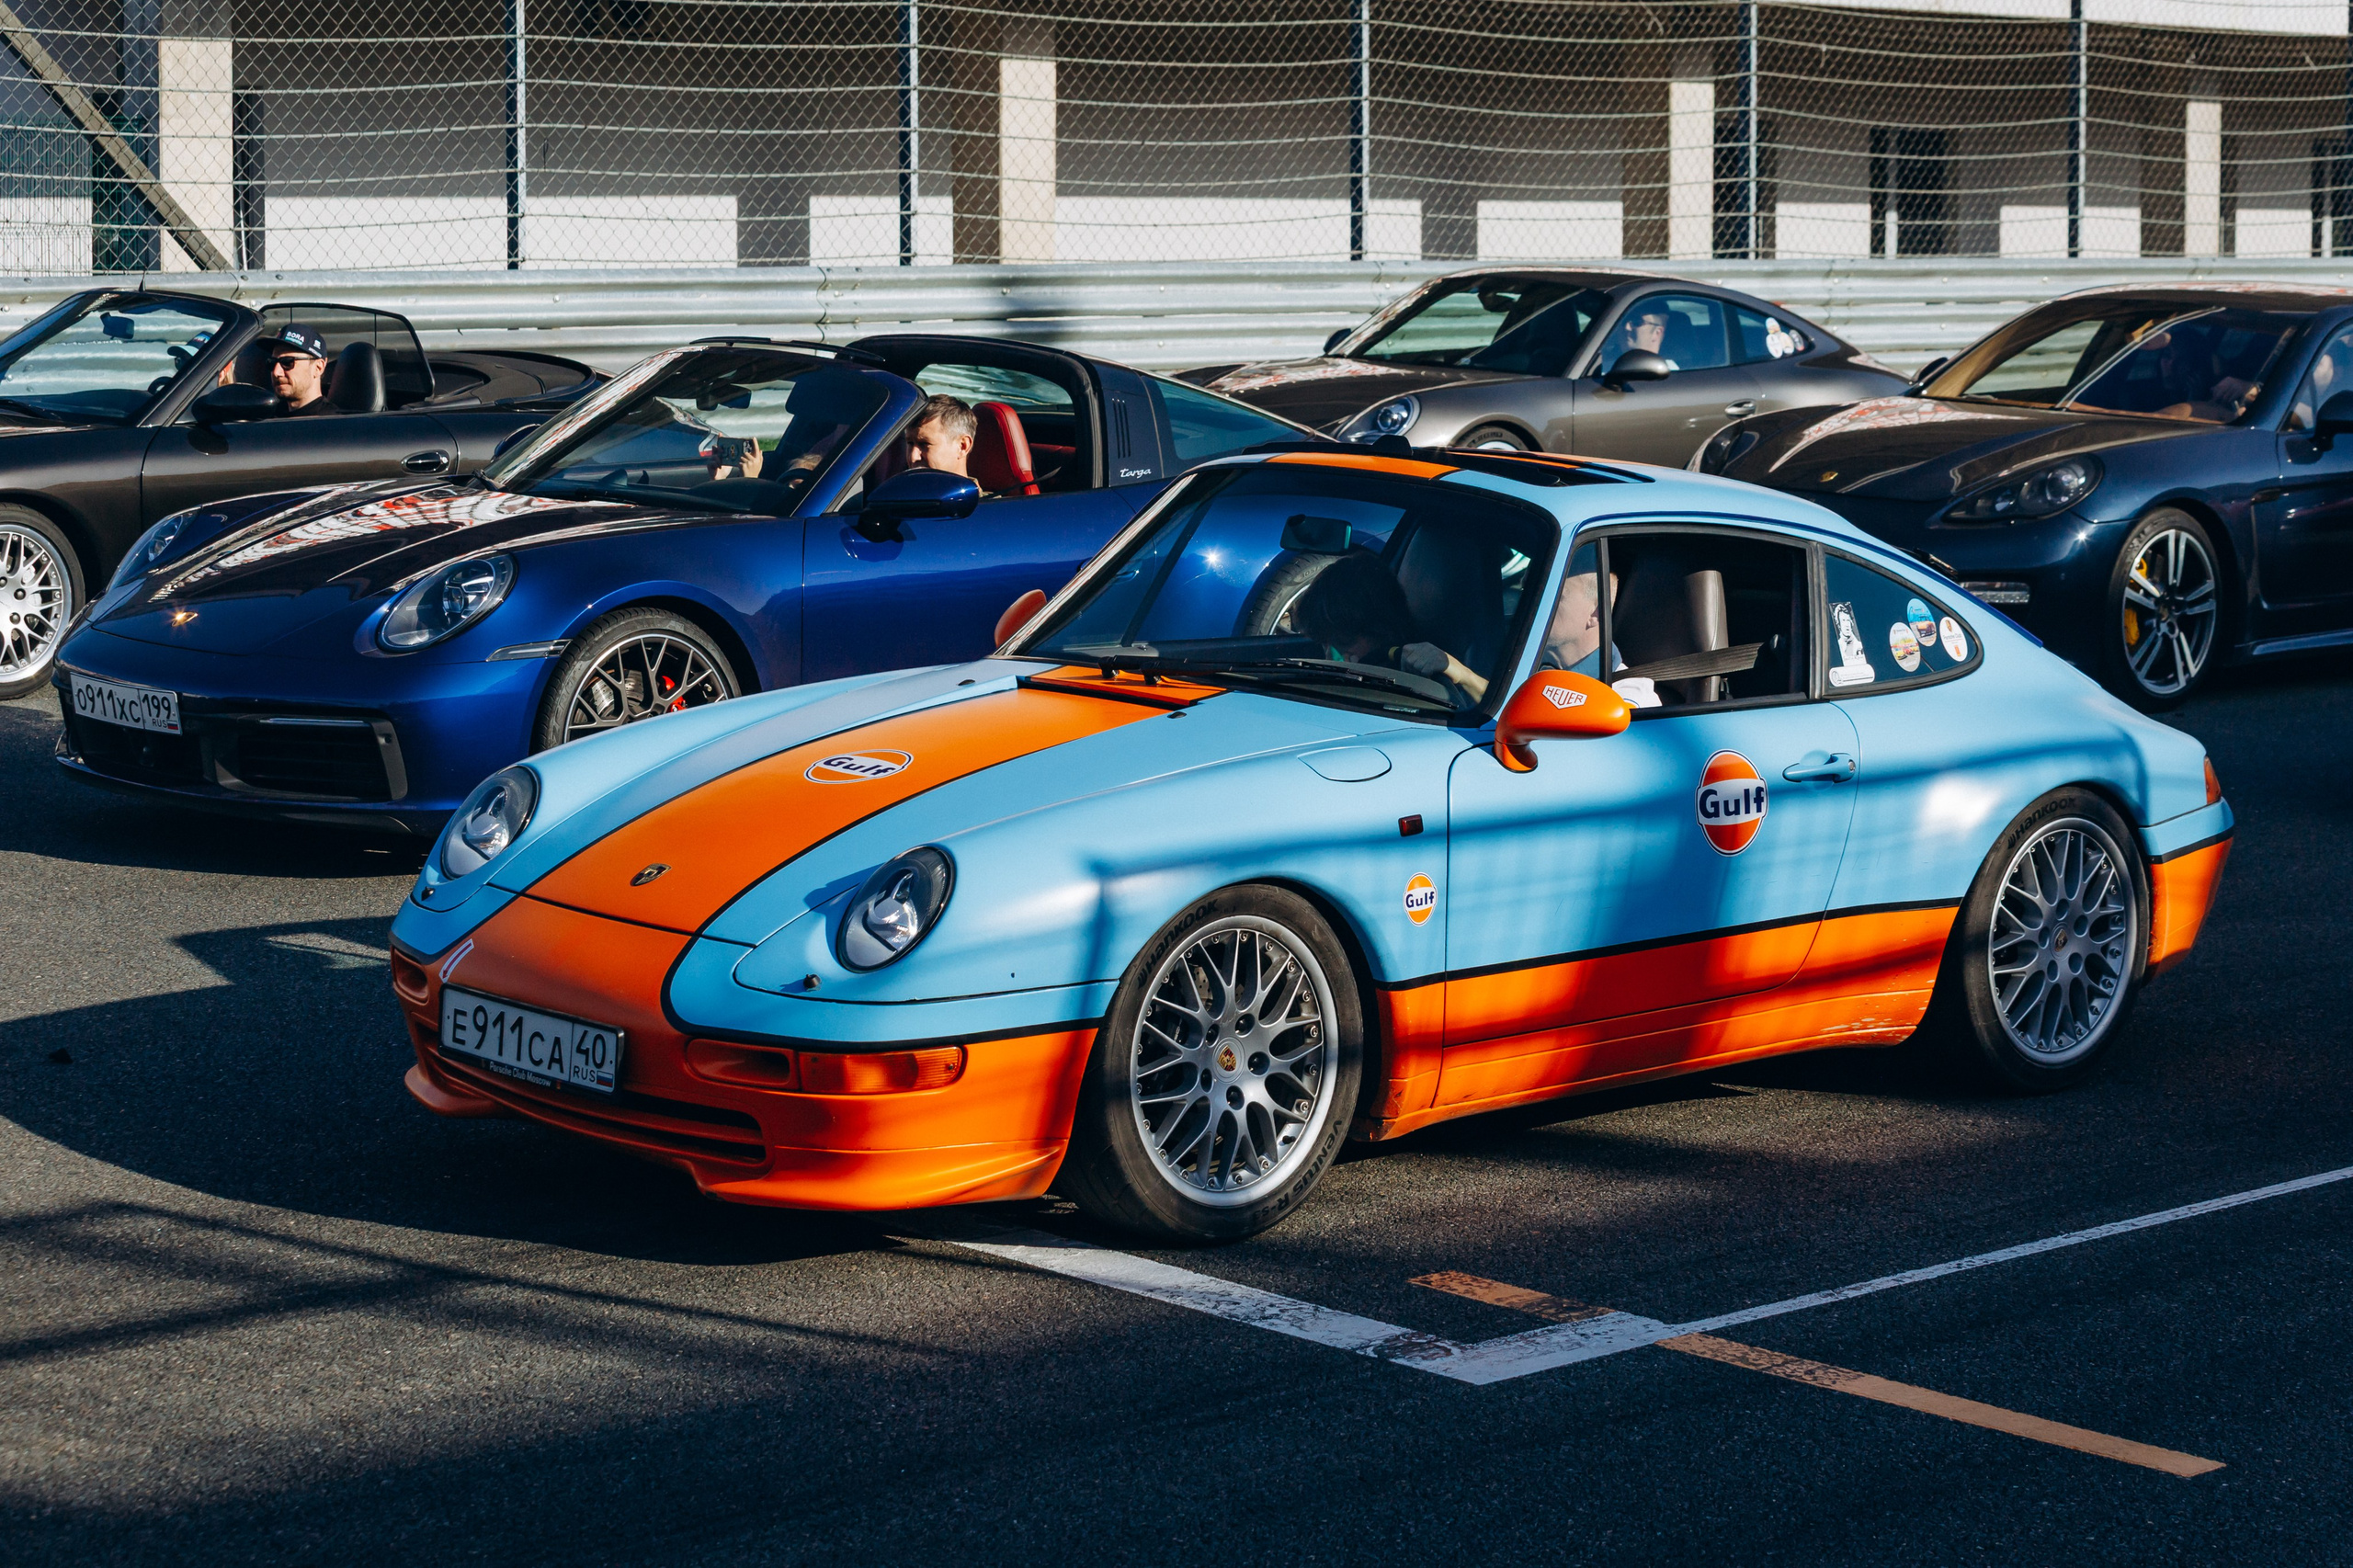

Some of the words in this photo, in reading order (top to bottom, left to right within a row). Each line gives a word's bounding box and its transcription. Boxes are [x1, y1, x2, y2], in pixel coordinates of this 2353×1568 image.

[287, 331, 304, 343] BORA
[1545, 687, 1584, 706] HEUER
[142, 693, 171, 720] 199
[152, 720, 167, 729] RUS
[823, 756, 896, 776] Gulf
[1699, 786, 1765, 819] Gulf
[1405, 891, 1435, 908] Gulf
[451, 1005, 564, 1074] E911CA
[575, 1029, 607, 1070] 40
[489, 1061, 512, 1076] Porsche
[512, 1067, 527, 1080] Club
[573, 1064, 596, 1083] RUS
